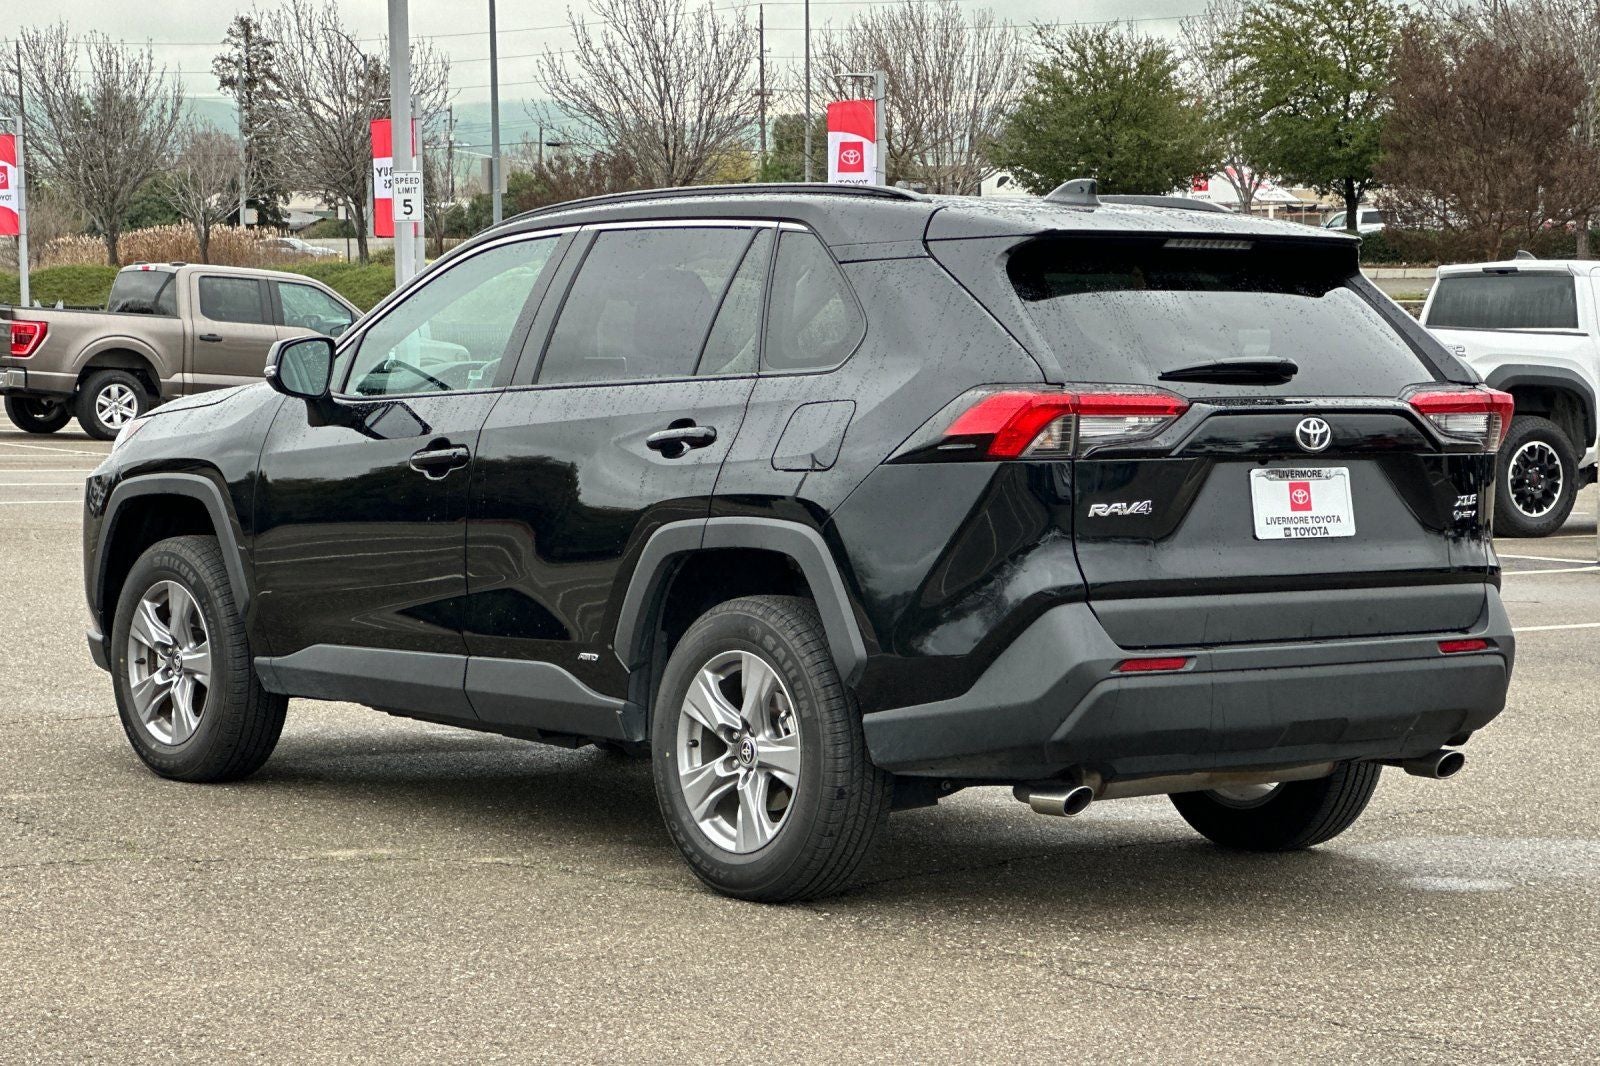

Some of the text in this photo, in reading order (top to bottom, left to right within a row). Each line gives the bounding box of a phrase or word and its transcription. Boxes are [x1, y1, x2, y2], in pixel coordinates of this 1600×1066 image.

[395, 177, 420, 185] SPEED
[403, 199, 413, 215] 5
[1278, 469, 1322, 478] LIVERMORE
[1454, 494, 1477, 506] XLE
[1088, 500, 1152, 517] RAV4
[1266, 515, 1341, 525] LIVERMORE TOYOTA
[1294, 526, 1329, 537] TOYOTA
